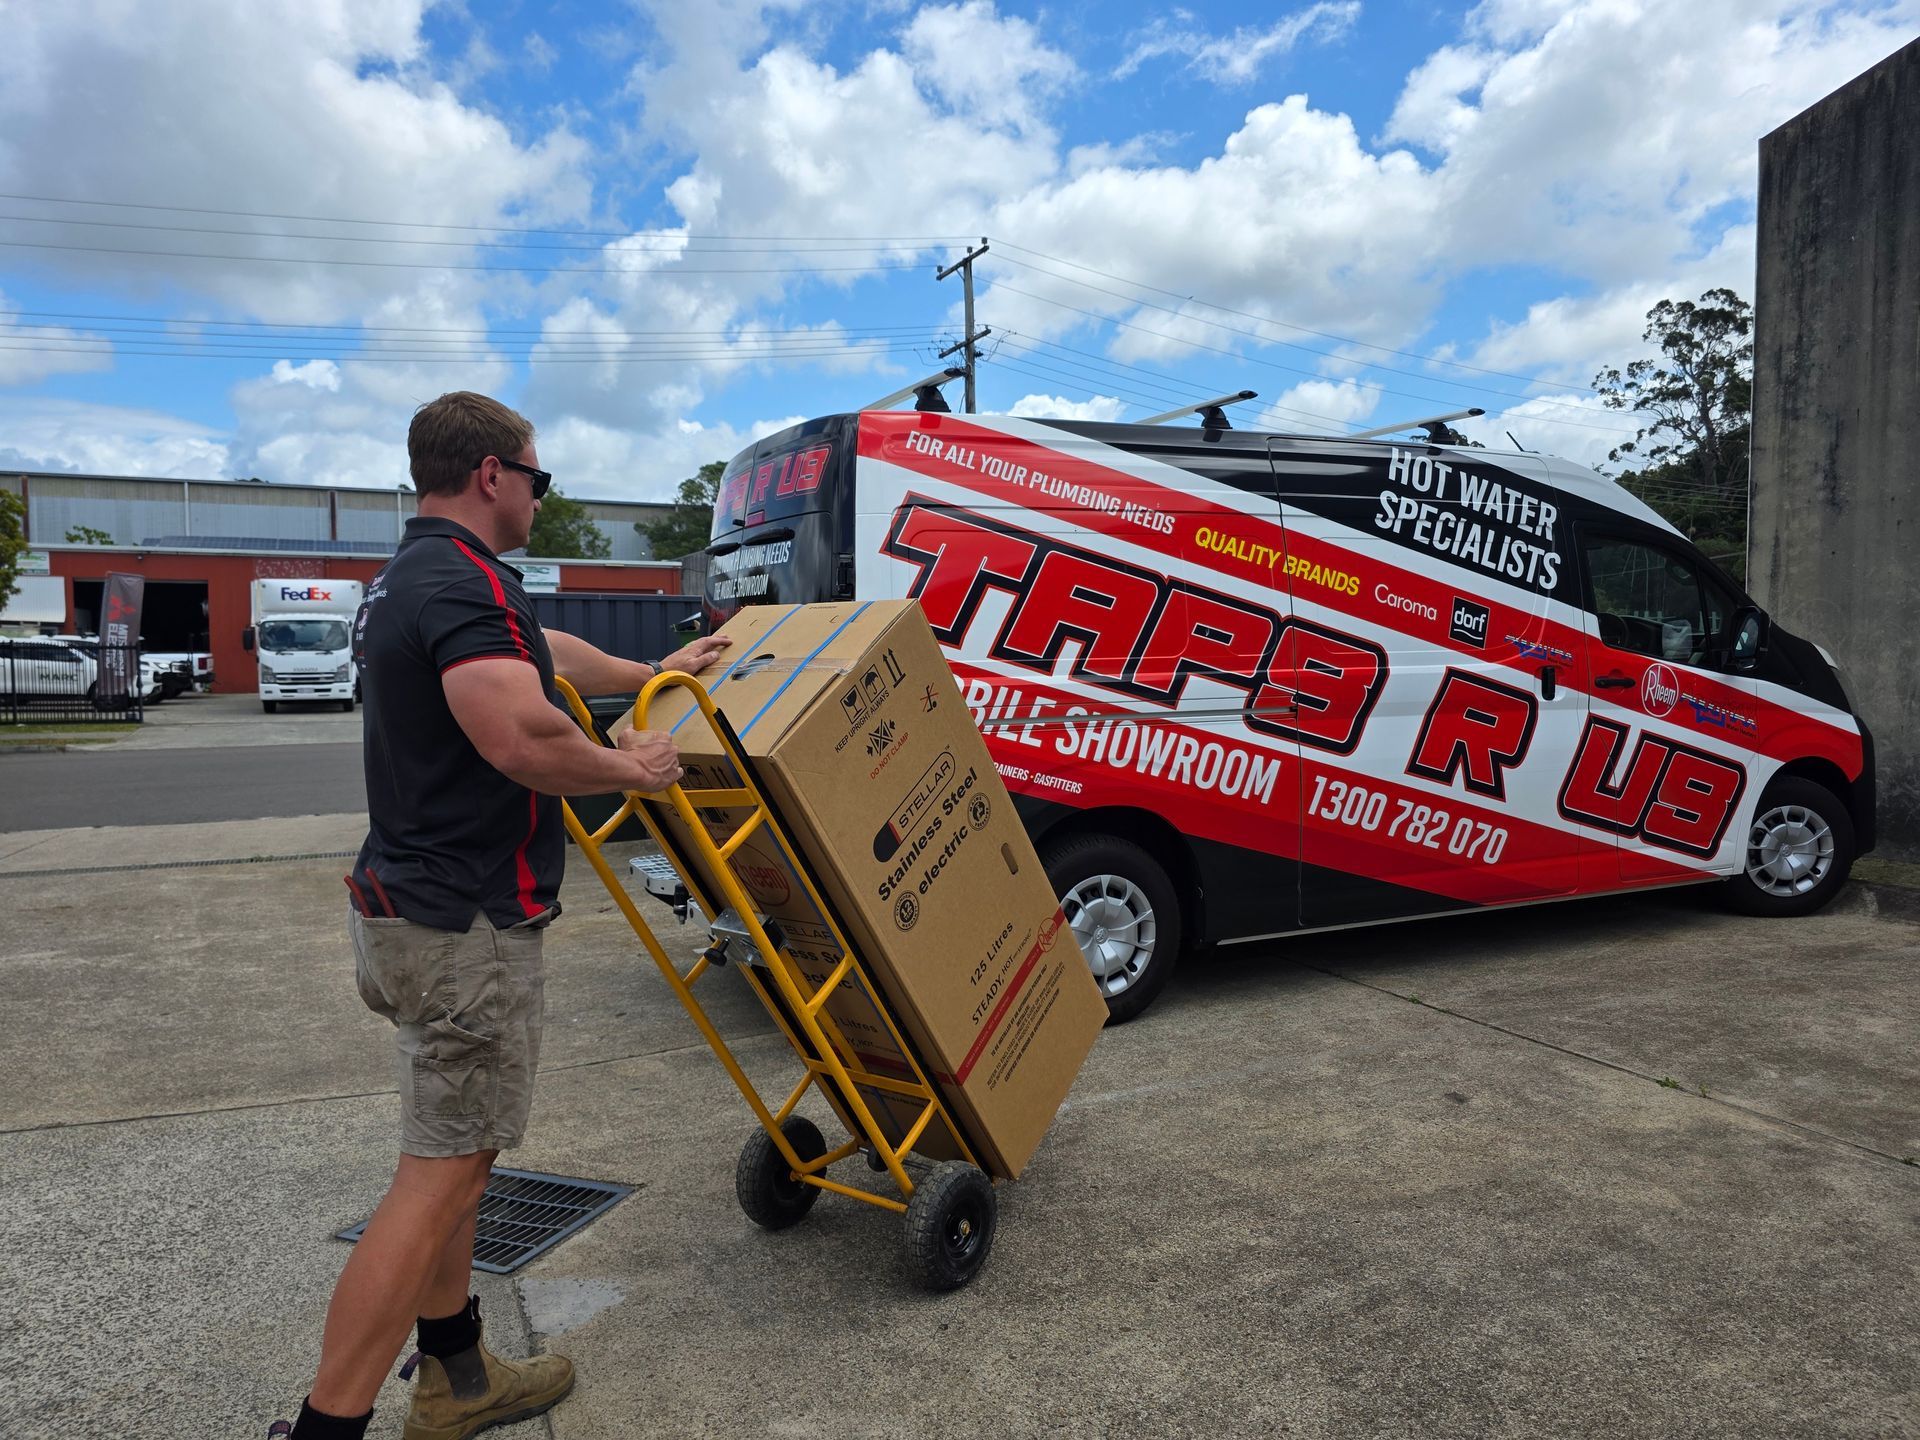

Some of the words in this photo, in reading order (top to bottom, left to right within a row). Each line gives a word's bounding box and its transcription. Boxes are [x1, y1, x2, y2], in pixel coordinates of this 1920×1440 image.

[776, 444, 832, 500] US
[906, 430, 942, 458] FOR
[945, 444, 975, 471] ALL
[981, 454, 1028, 487] YOUR
[1029, 472, 1122, 517] PLUMBING
[1121, 501, 1176, 534] NEEDS
[1388, 448, 1452, 498] HOT
[1459, 470, 1558, 541] WATER
[764, 541, 791, 565] NEEDS
[1195, 527, 1281, 568] QUALITY
[1283, 555, 1361, 596] BRANDS
[1374, 491, 1562, 590] SPECIALISTS
[281, 587, 332, 601] FedEx
[1374, 584, 1438, 621] Caroma
[1454, 606, 1487, 633] dorf
[879, 490, 1390, 758] TAPS
[1404, 666, 1538, 803] R
[1557, 712, 1747, 861] US
[1645, 665, 1676, 707] Rheem
[834, 735, 849, 753] KEEP
[849, 714, 871, 739] UPRIGHT
[870, 690, 890, 715] ALWAYS
[952, 673, 1057, 748] BILE
[1055, 706, 1281, 804] SHOWROOM
[870, 769, 880, 780] DO
[879, 756, 891, 770] NOT
[890, 732, 909, 756] CLAMP
[1034, 772, 1083, 794] GASFITTERS
[899, 760, 951, 829] STELLAR
[1308, 776, 1387, 831] 1300
[1387, 799, 1449, 849] 782
[1448, 818, 1508, 865] 070
[878, 817, 942, 901] Stainless
[942, 766, 977, 816] Steel
[919, 825, 969, 894] electric
[971, 962, 988, 987] 125
[988, 922, 1013, 962] Litres
[1038, 921, 1056, 949] Rheem
[972, 975, 1005, 1026] STEADY,
[1002, 955, 1015, 976] HOT
